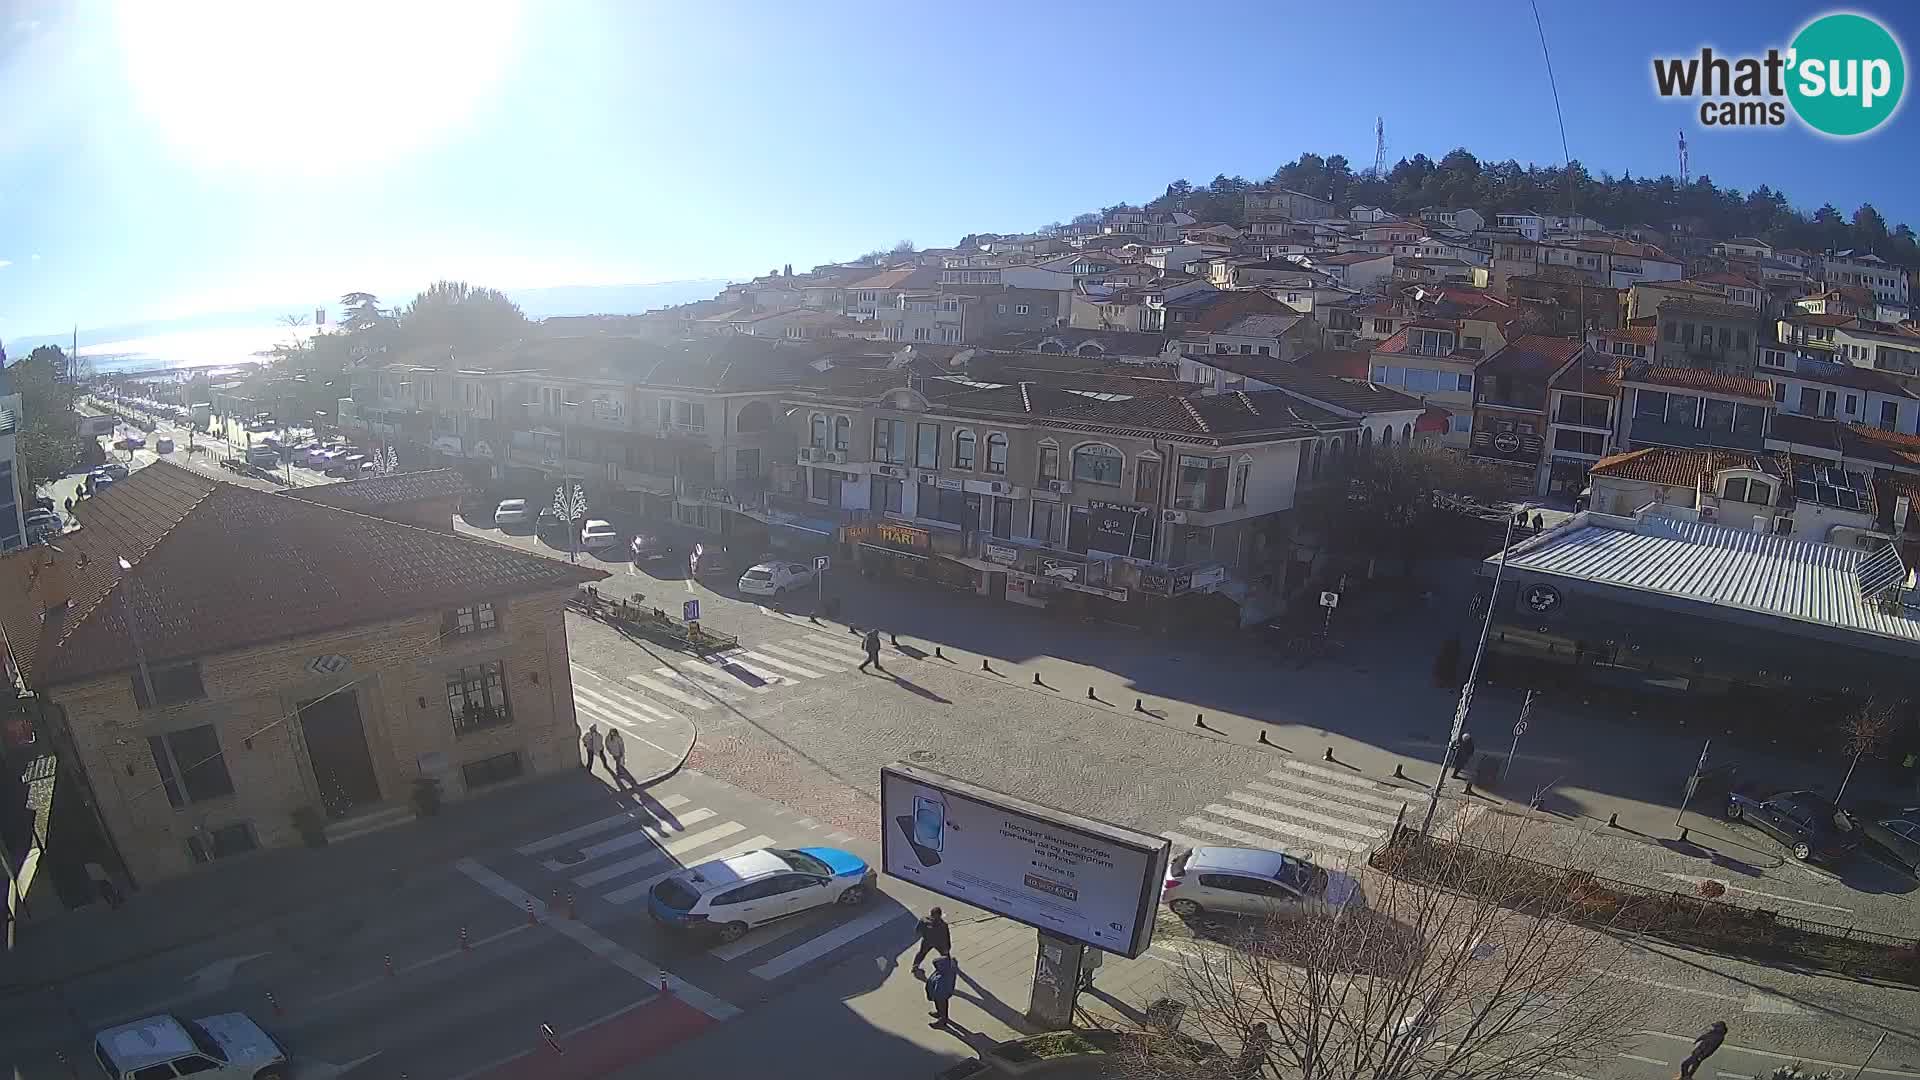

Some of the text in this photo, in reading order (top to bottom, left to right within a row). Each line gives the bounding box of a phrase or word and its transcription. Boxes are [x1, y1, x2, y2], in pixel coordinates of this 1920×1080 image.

[882, 528, 914, 545] HARI
[1003, 820, 1043, 840] Постојат
[1081, 845, 1112, 861] добри
[1037, 842, 1049, 850] да
[1033, 848, 1045, 857] на
[1037, 862, 1075, 879] iPhone 15
